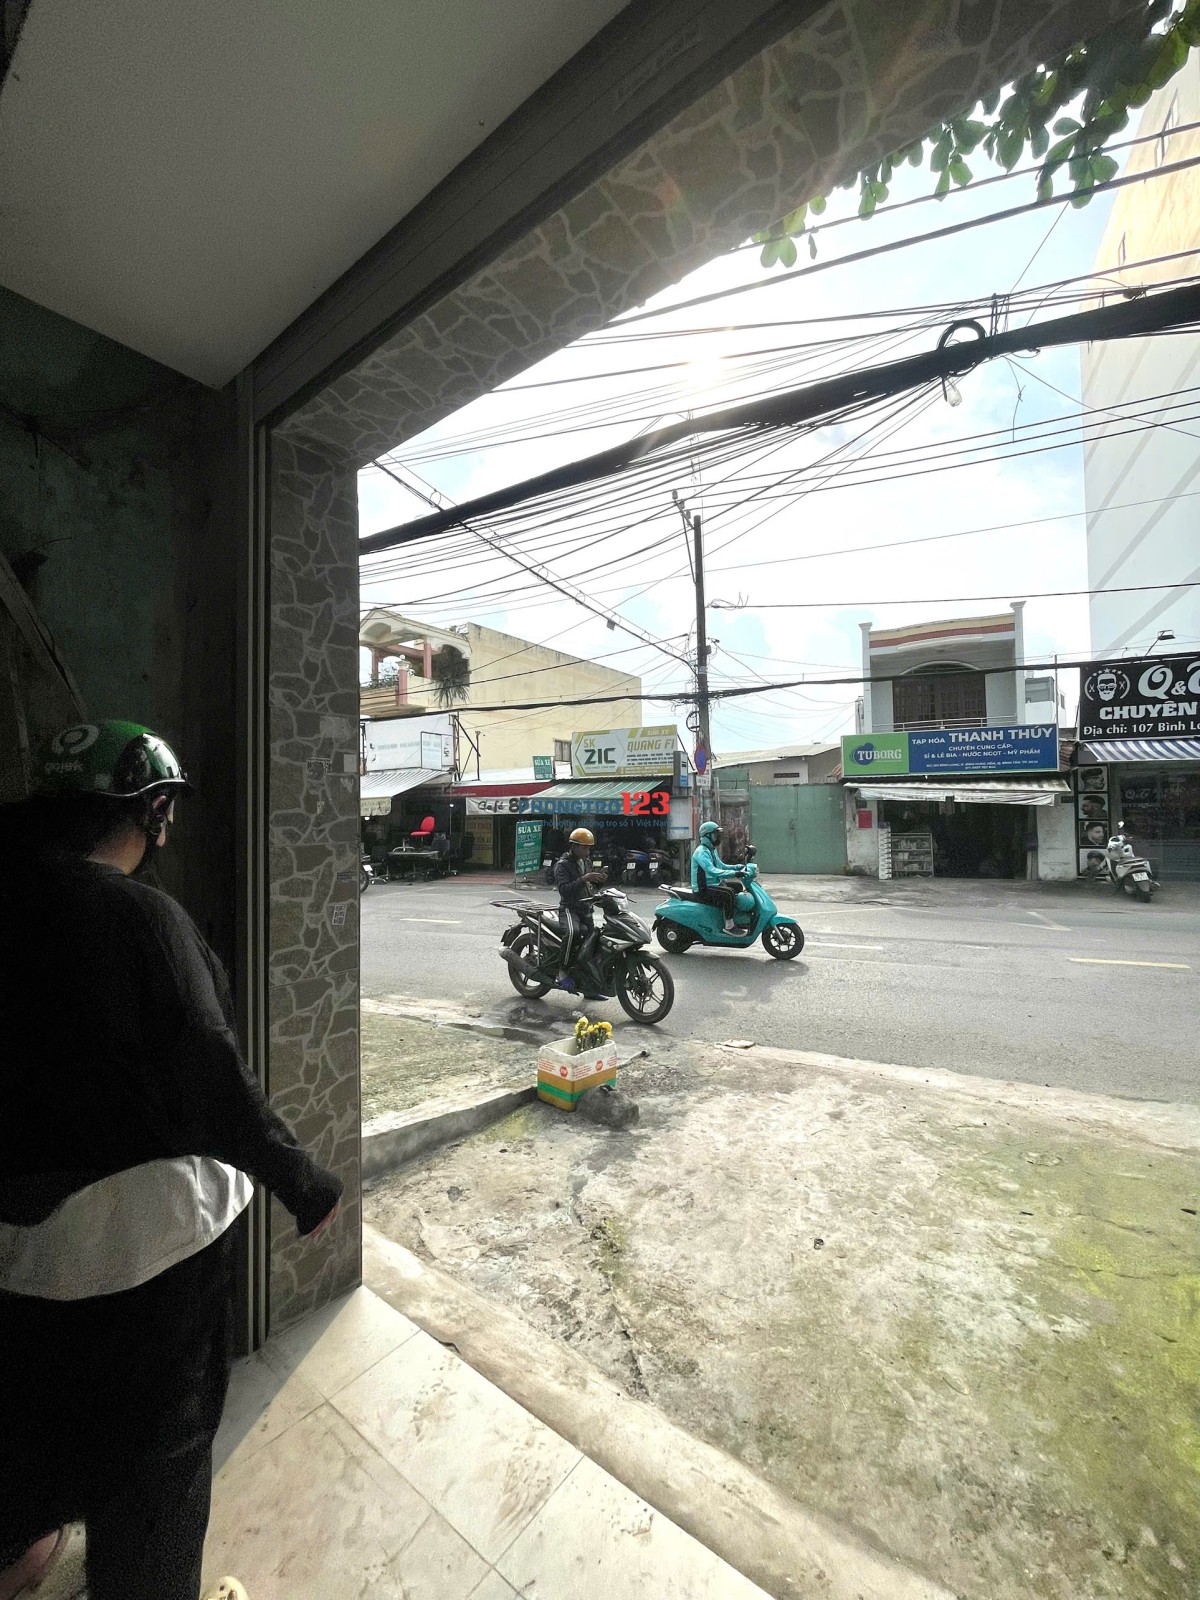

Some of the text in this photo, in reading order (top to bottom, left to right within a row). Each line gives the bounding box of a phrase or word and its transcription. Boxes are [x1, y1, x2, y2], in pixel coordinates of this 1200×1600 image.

[1099, 700, 1198, 720] CHUYÊN
[1083, 725, 1103, 737] Địa
[1132, 723, 1154, 733] 107
[1158, 721, 1185, 731] Bình
[948, 730, 1003, 743] THANH
[583, 739, 595, 748] SK
[627, 739, 662, 752] QUANG
[584, 747, 616, 765] ZIC
[857, 749, 902, 761] TUBORG
